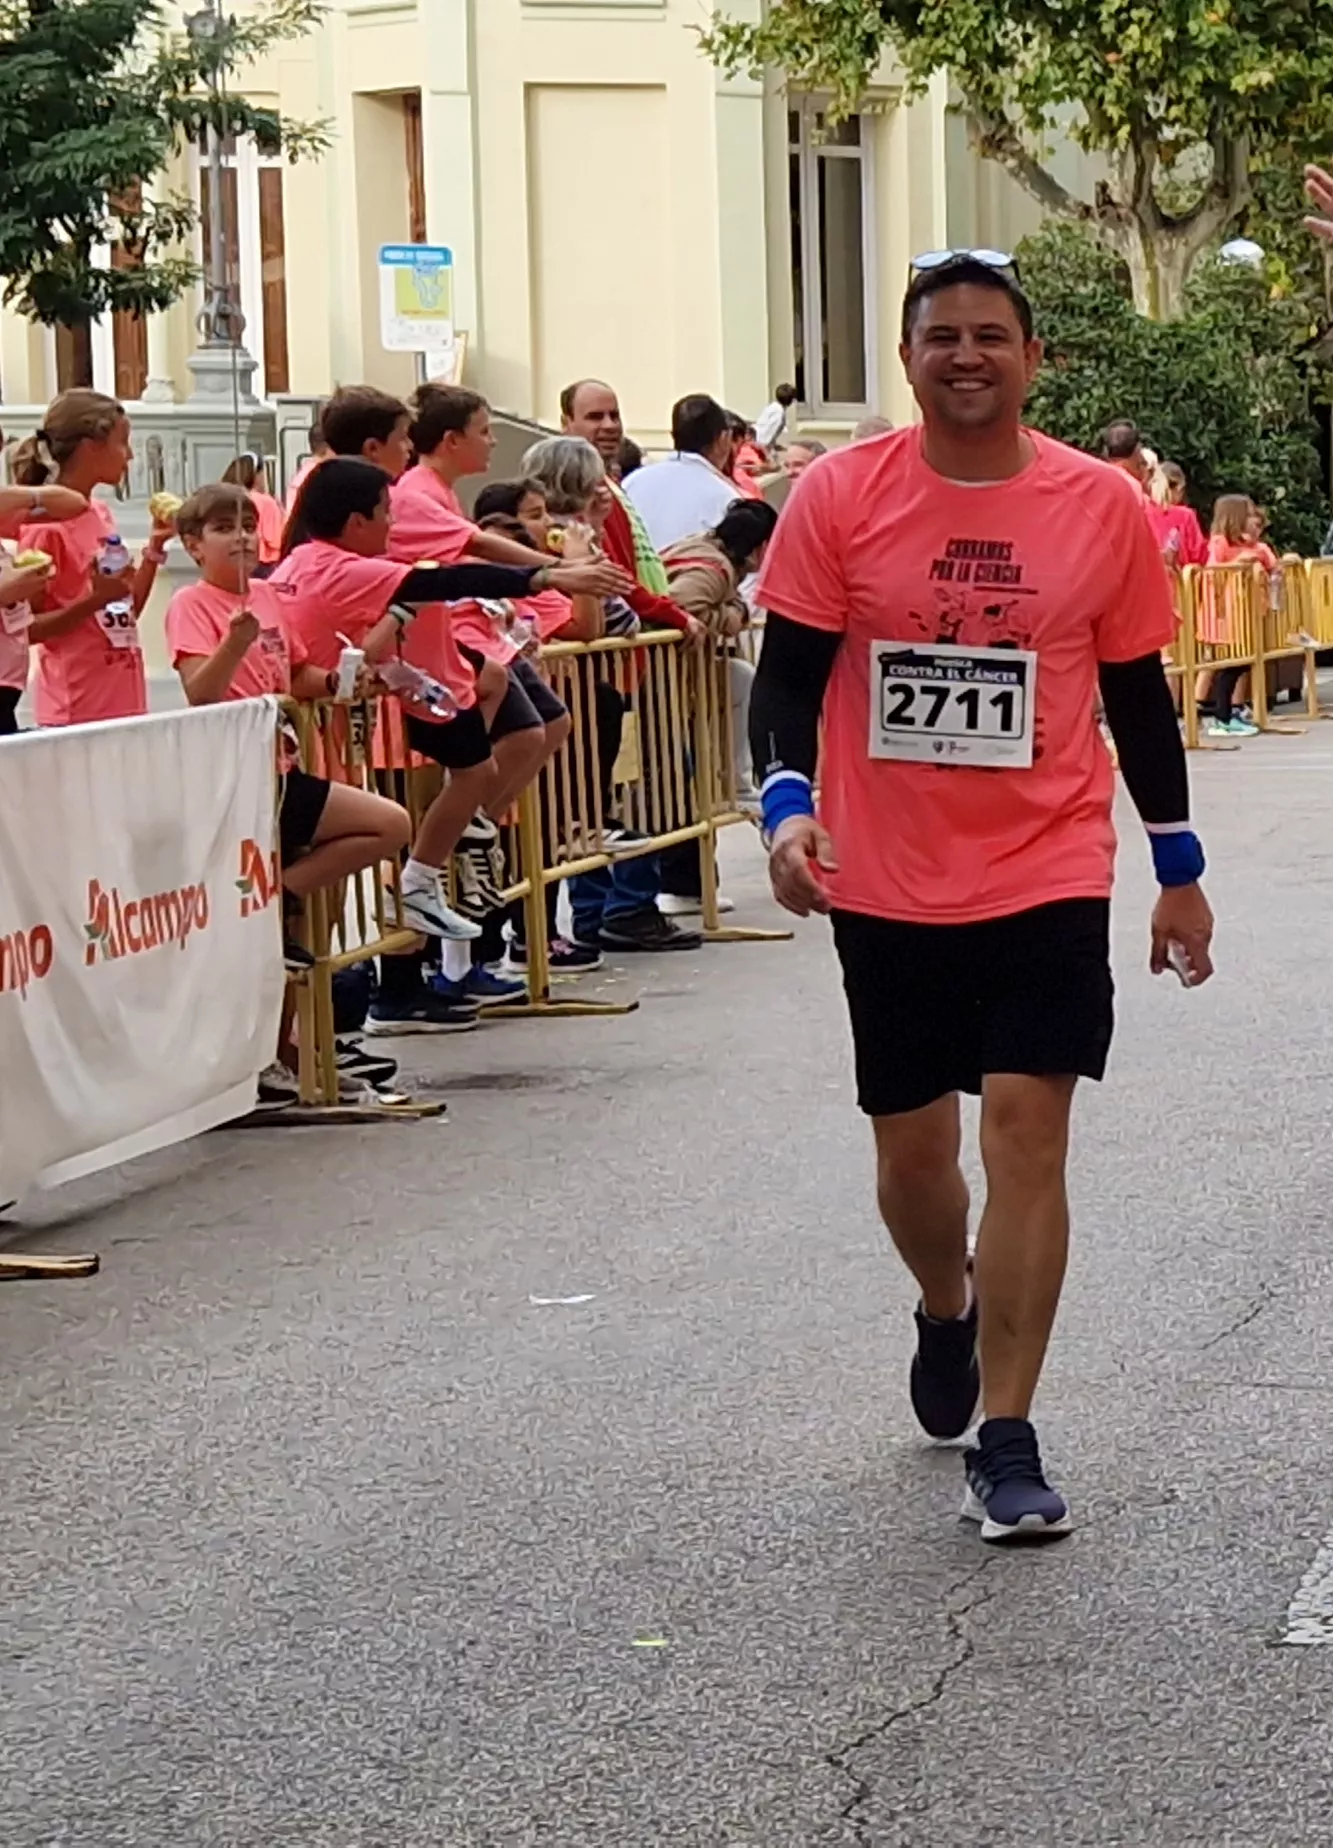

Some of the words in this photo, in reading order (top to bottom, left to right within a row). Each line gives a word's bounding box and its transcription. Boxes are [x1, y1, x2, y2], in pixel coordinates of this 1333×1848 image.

[888, 664, 943, 680] CONTRA
[947, 667, 961, 682] EL
[965, 668, 1018, 684] CÁNCER
[886, 683, 1015, 732] 2711
[83, 878, 209, 967] Alcampo
